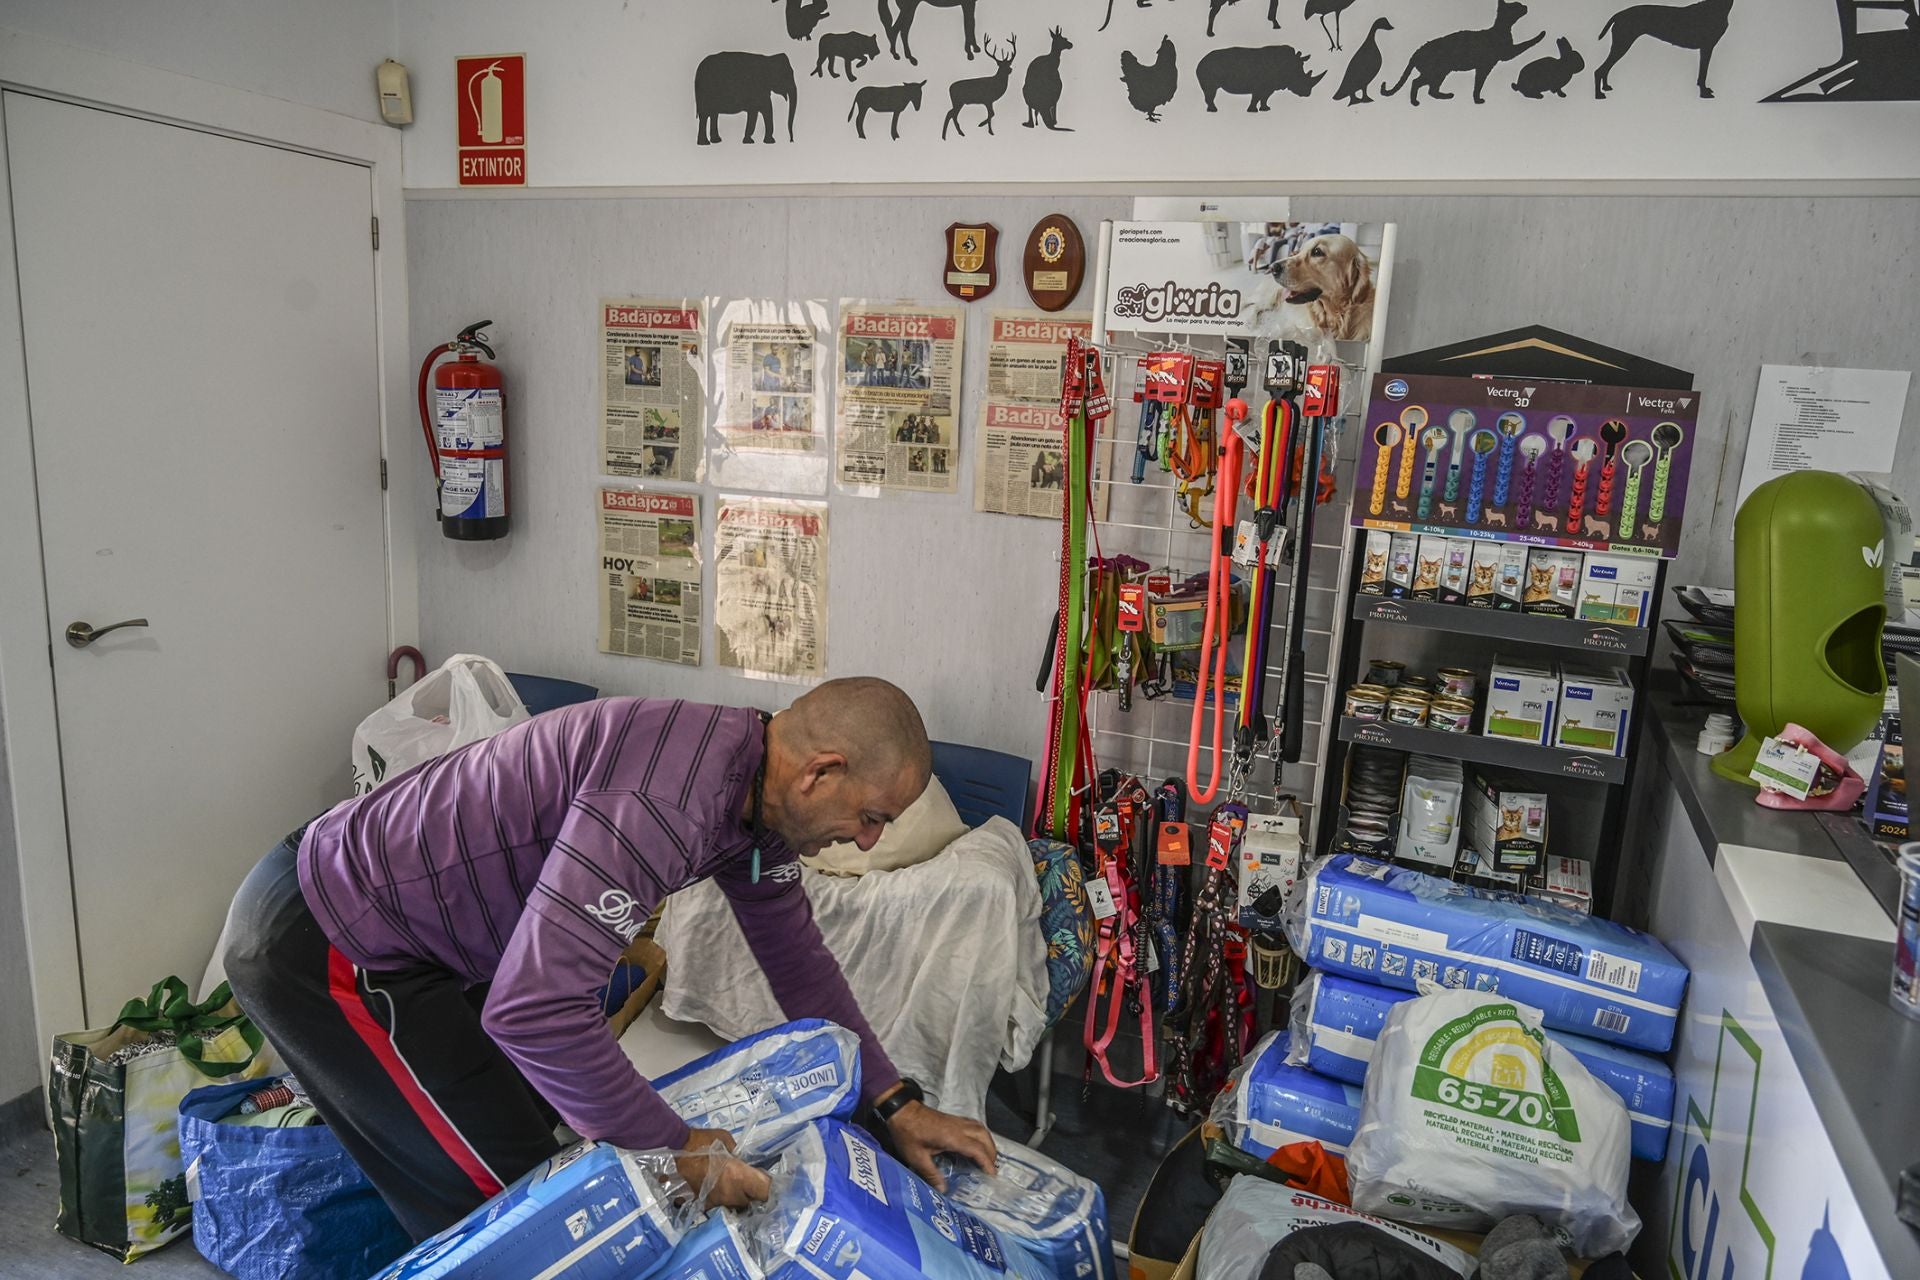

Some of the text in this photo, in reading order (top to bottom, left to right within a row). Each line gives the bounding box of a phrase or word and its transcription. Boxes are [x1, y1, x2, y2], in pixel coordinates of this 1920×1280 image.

[463, 157, 522, 177] EXTINTOR
[1119, 228, 1163, 236] gloriapets.com
[1118, 236, 1181, 245] creacionesgloria.com
[608, 309, 672, 328] Badajoz
[853, 316, 928, 336] Badajoz
[1001, 321, 1083, 344] Badajoz
[1487, 386, 1519, 399] Vectra
[1514, 397, 1530, 408] 3D
[1638, 396, 1675, 409] Vectra
[995, 406, 1065, 430] Badajo
[606, 492, 669, 512] Badajoz
[1422, 525, 1445, 535] 4-10kg
[1469, 529, 1496, 540] 10-25kg
[1519, 534, 1546, 545] 25-40kg
[1571, 540, 1594, 549] >40kg
[1611, 544, 1631, 553] Gatos
[603, 556, 634, 572] HOY
[1592, 567, 1615, 575] Virbac
[1369, 611, 1408, 621] PRO PLAN
[1583, 638, 1627, 649] PRO PLAN
[1496, 680, 1518, 688] Virbac
[1568, 688, 1591, 697] Virbac
[1354, 733, 1392, 744] PRO PLAN
[1563, 765, 1605, 777] PRO PLAN
[1880, 824, 1908, 836] 2024
[1555, 952, 1565, 966] 40
[1567, 952, 1575, 967] TALLA
[1607, 1005, 1623, 1014] GTIN
[1427, 1033, 1451, 1062] REUSABLE
[791, 1068, 836, 1091] LINDOR
[1423, 1109, 1459, 1123] RECYCLED
[1460, 1119, 1494, 1134] MATERIAL
[1500, 1130, 1536, 1146] MATERIAL
[1425, 1119, 1459, 1134] MATERIAL
[1460, 1128, 1495, 1142] RECICLAT
[1500, 1139, 1538, 1155] MATERIAU
[1455, 1136, 1539, 1165] MATERIAL BIRZIKLATUA
[806, 1218, 831, 1253] LINDOR
[822, 1229, 846, 1263] Elásticos
